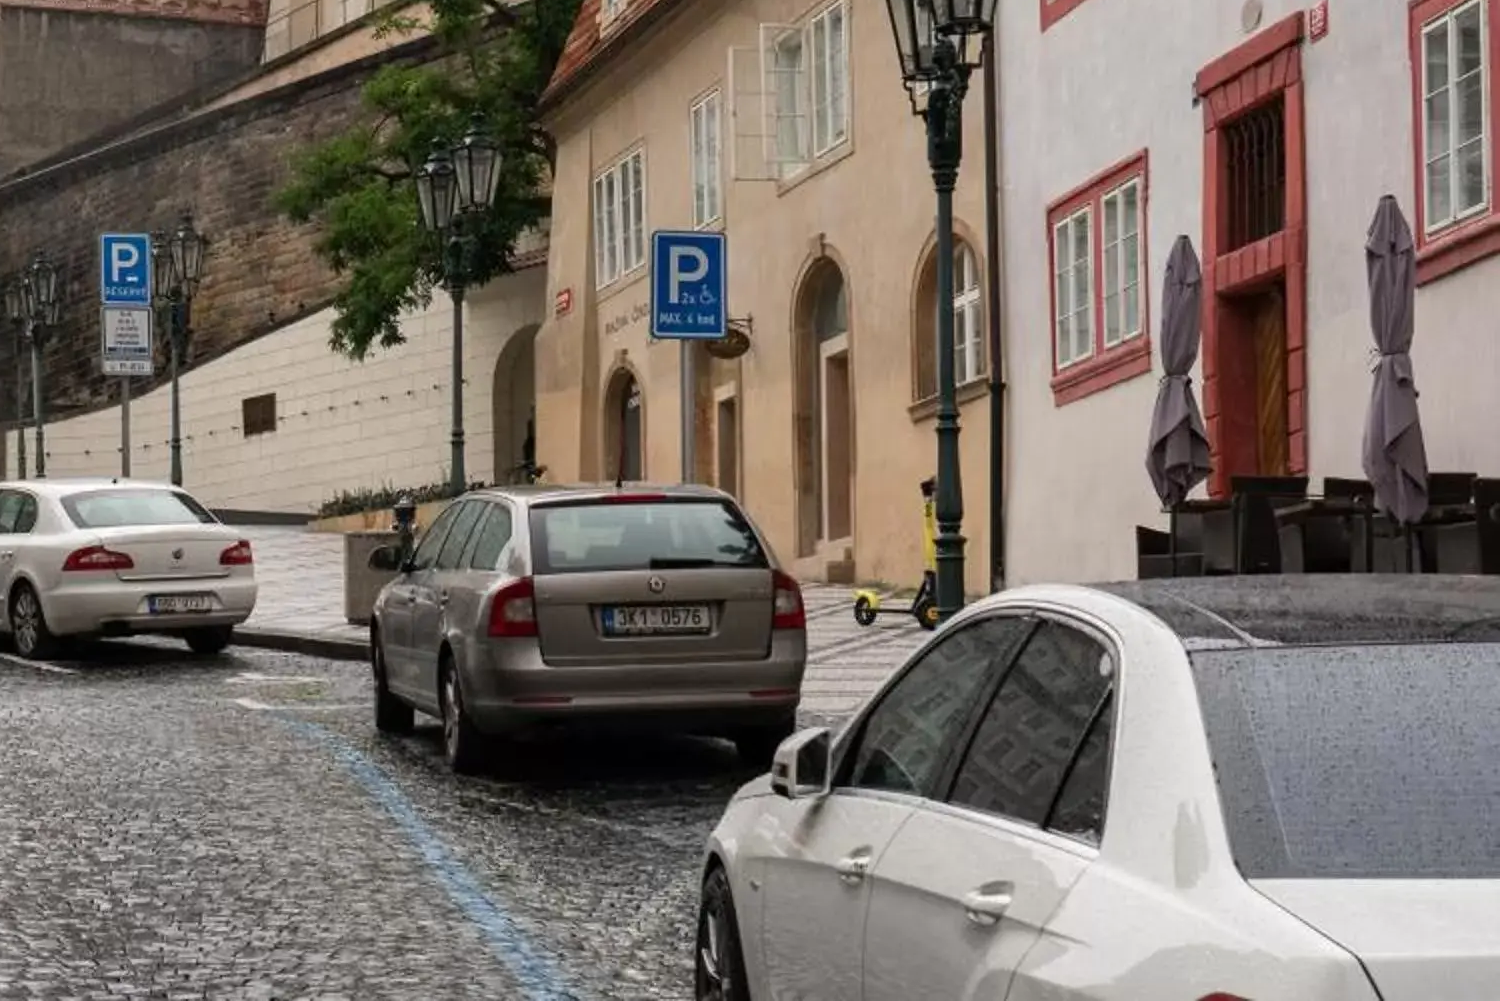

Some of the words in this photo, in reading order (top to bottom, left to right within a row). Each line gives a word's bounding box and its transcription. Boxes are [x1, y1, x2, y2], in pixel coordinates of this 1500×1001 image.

[111, 242, 139, 282] P
[668, 246, 709, 304] P
[661, 607, 701, 626] 0576
